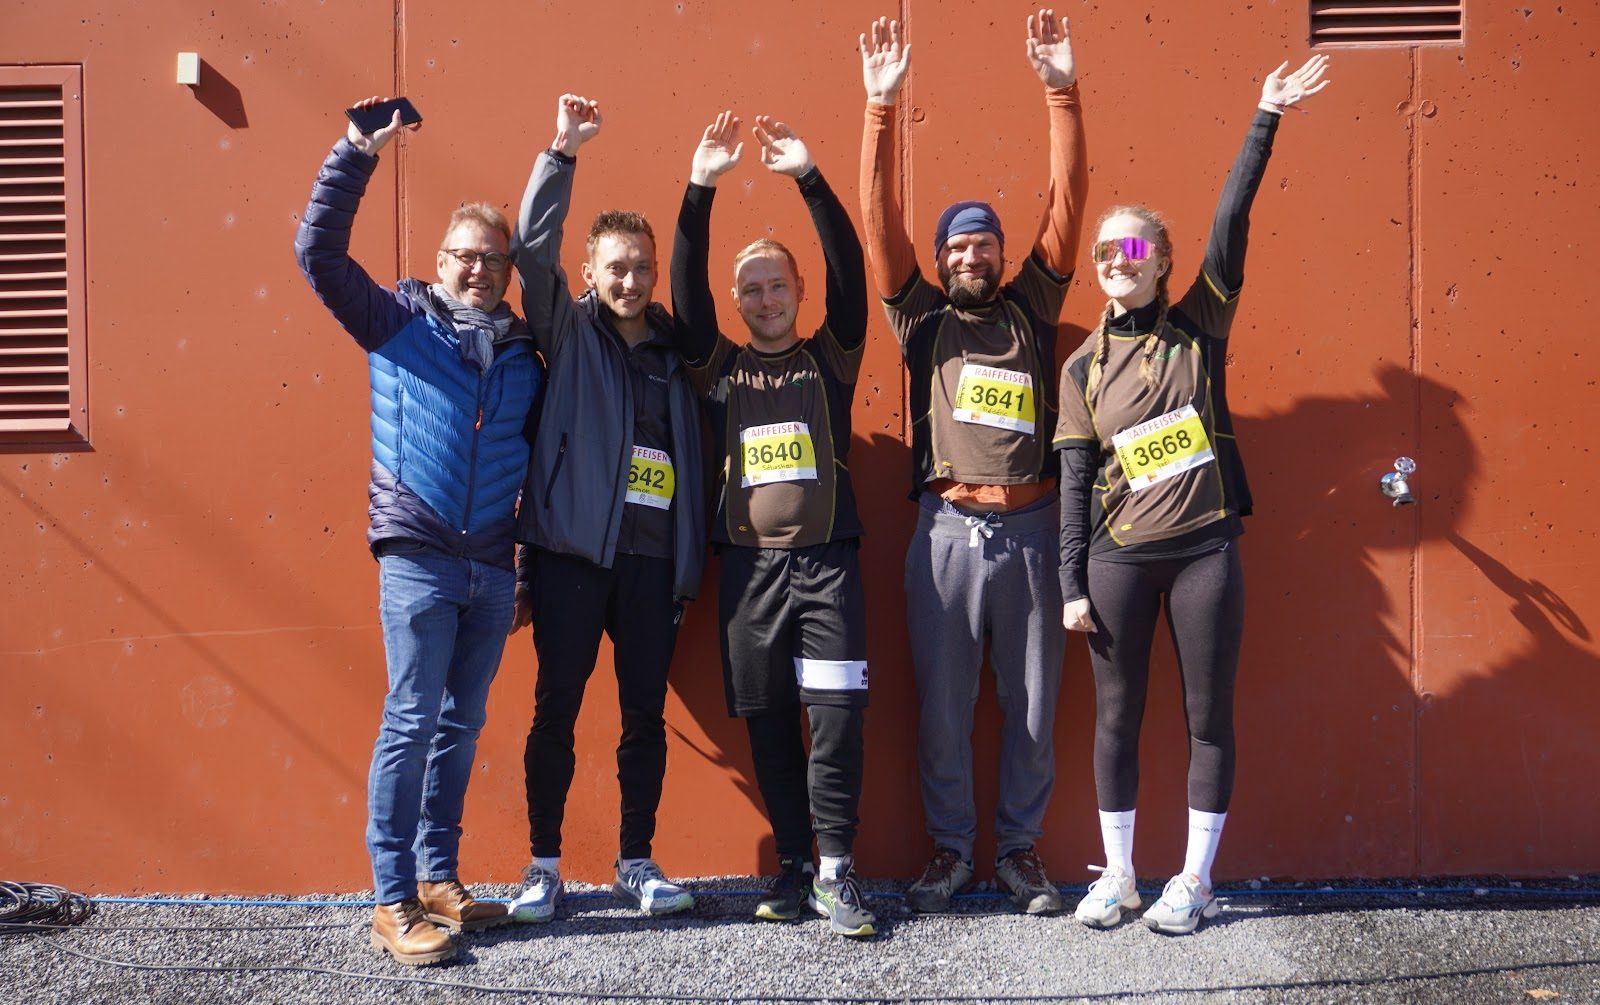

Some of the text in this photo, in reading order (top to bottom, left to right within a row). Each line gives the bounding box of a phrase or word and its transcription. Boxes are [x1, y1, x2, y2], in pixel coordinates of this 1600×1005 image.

[975, 367, 1030, 385] RAIFFEISEN
[970, 385, 1025, 412] 3641
[744, 423, 801, 438] RAIFFEISEN
[1125, 410, 1182, 440] RAIFFEISEN
[747, 441, 802, 466] 3640
[1133, 429, 1192, 467] 3668
[628, 464, 665, 489] 642
